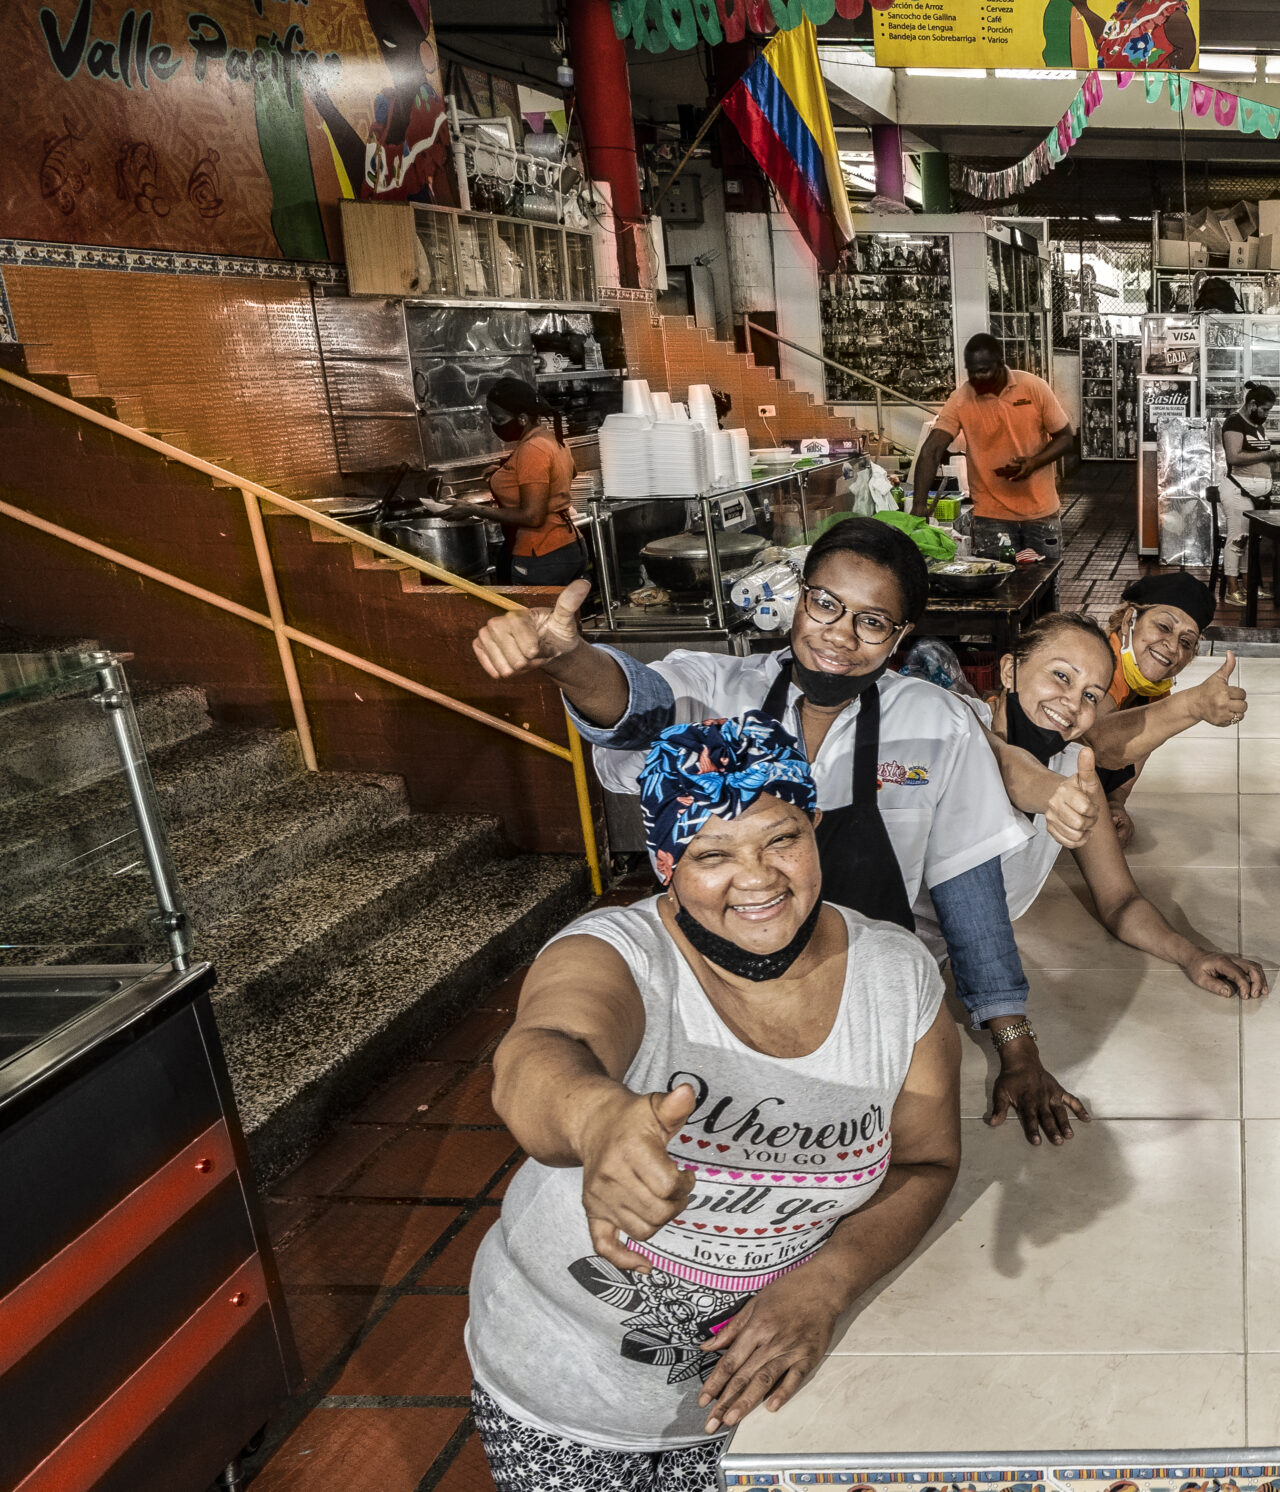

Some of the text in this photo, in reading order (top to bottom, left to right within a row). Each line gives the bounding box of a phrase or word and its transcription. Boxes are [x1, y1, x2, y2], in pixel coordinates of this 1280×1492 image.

[890, 2, 913, 10] orción
[925, 3, 943, 11] Arroz
[986, 5, 1014, 13] Cerveza
[888, 12, 921, 20] Sancocho
[933, 14, 956, 22] Gallina
[888, 22, 953, 33] Bandeja de Lengua
[987, 25, 1013, 34] Porción
[889, 33, 916, 42] Bandeja
[932, 34, 976, 43] Sobrebarriga
[987, 36, 1008, 44] Varios
[39, 0, 182, 90] Valle
[1173, 332, 1196, 341] VISA
[1166, 351, 1187, 364] CAJA
[1145, 392, 1189, 405] Basilia
[667, 1071, 885, 1150] Wherever
[742, 1149, 827, 1166] YOU GO
[769, 1198, 844, 1226] go
[693, 1239, 809, 1266] love for live
